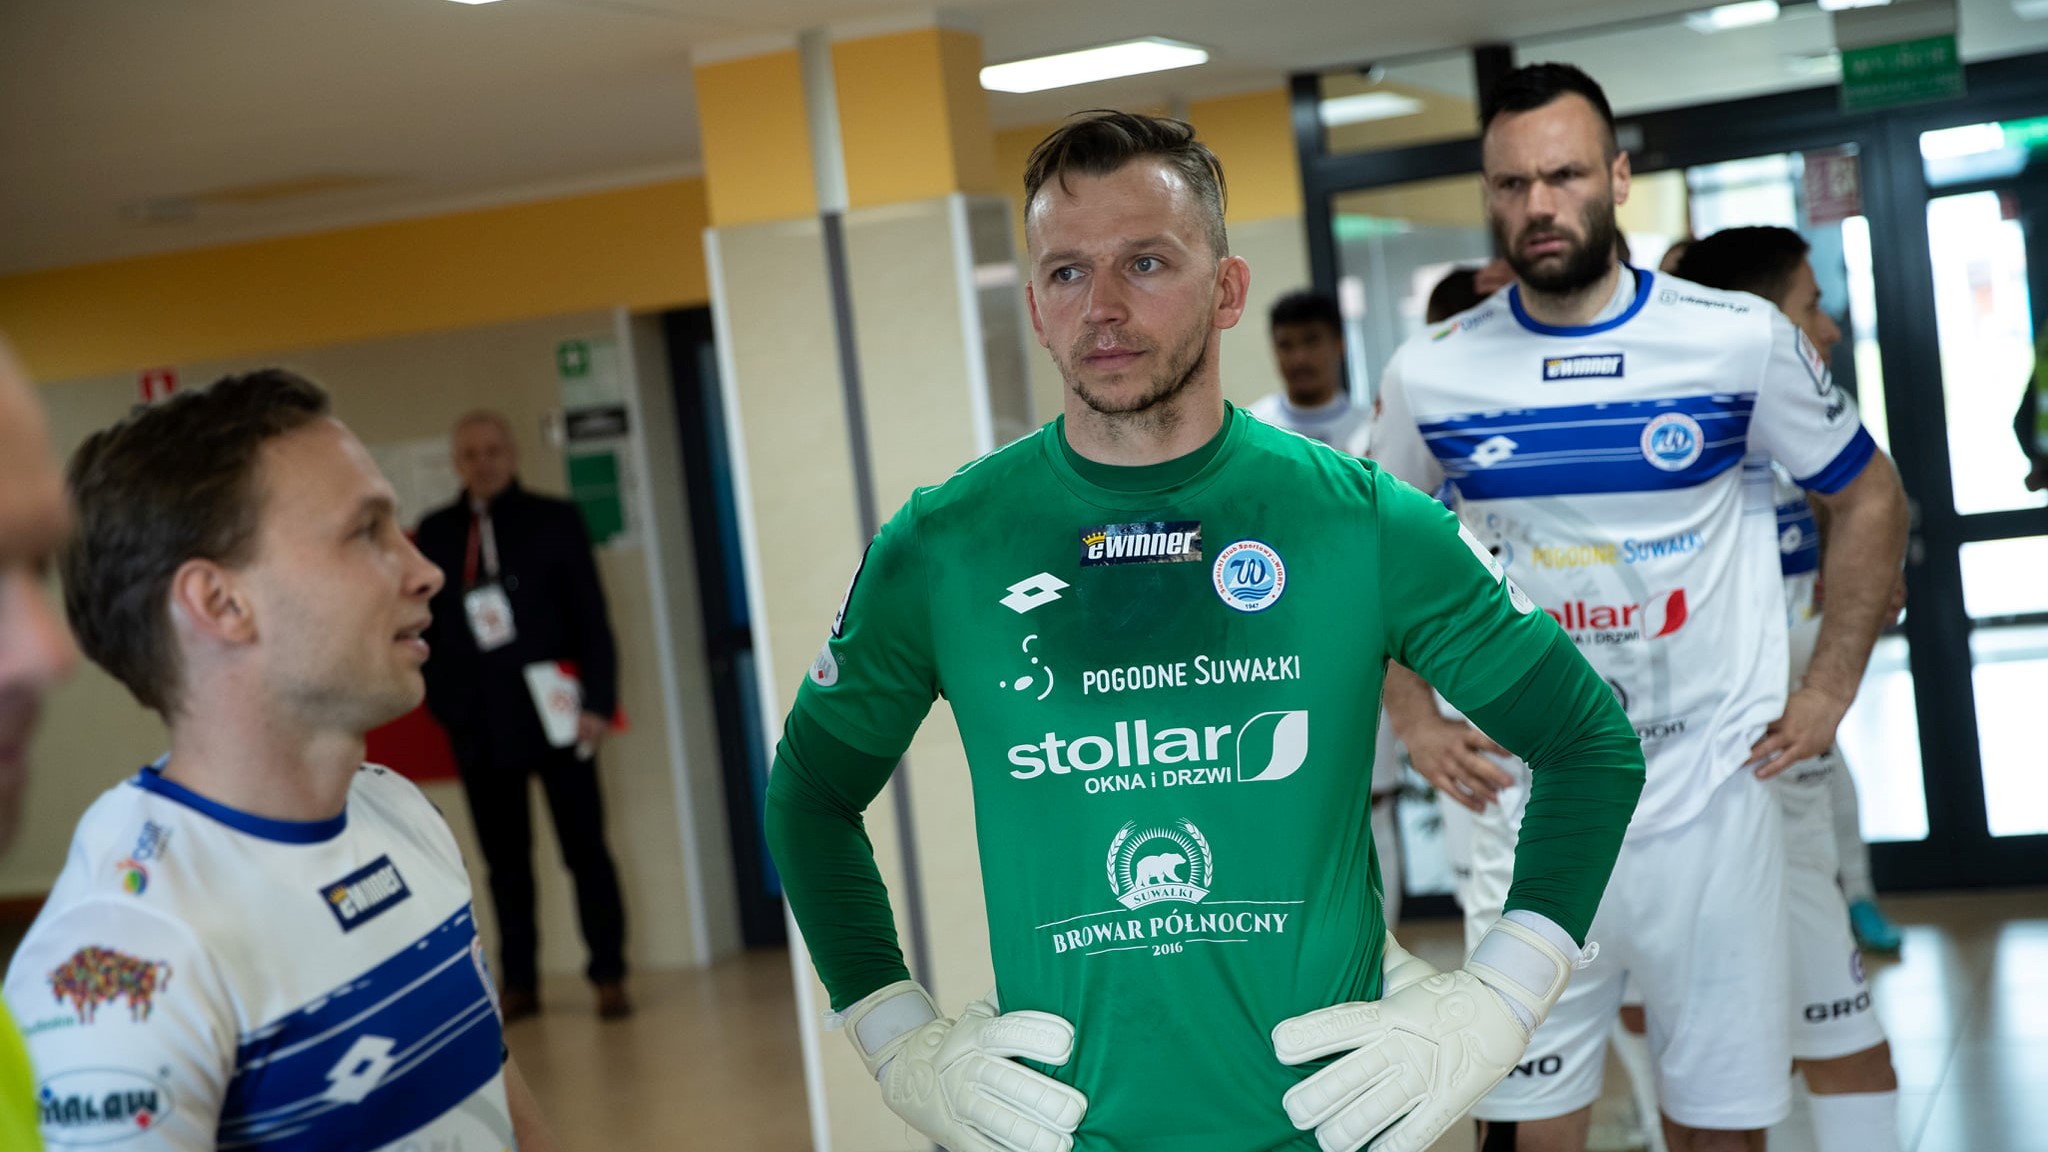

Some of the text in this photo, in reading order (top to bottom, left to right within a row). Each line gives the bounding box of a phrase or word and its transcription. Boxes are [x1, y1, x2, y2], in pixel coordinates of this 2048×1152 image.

[1088, 532, 1197, 560] ewinner
[1245, 602, 1260, 610] 1947
[1544, 600, 1640, 631] llar
[1082, 654, 1301, 695] POGODNE SUWAŁKI
[1007, 719, 1233, 780] stollar
[1084, 766, 1232, 795] OKNA i DRZWI
[1133, 888, 1194, 905] SUWAŁKI
[1052, 908, 1289, 954] BROWAR PÓŁNOCNY
[1151, 941, 1184, 957] 2016
